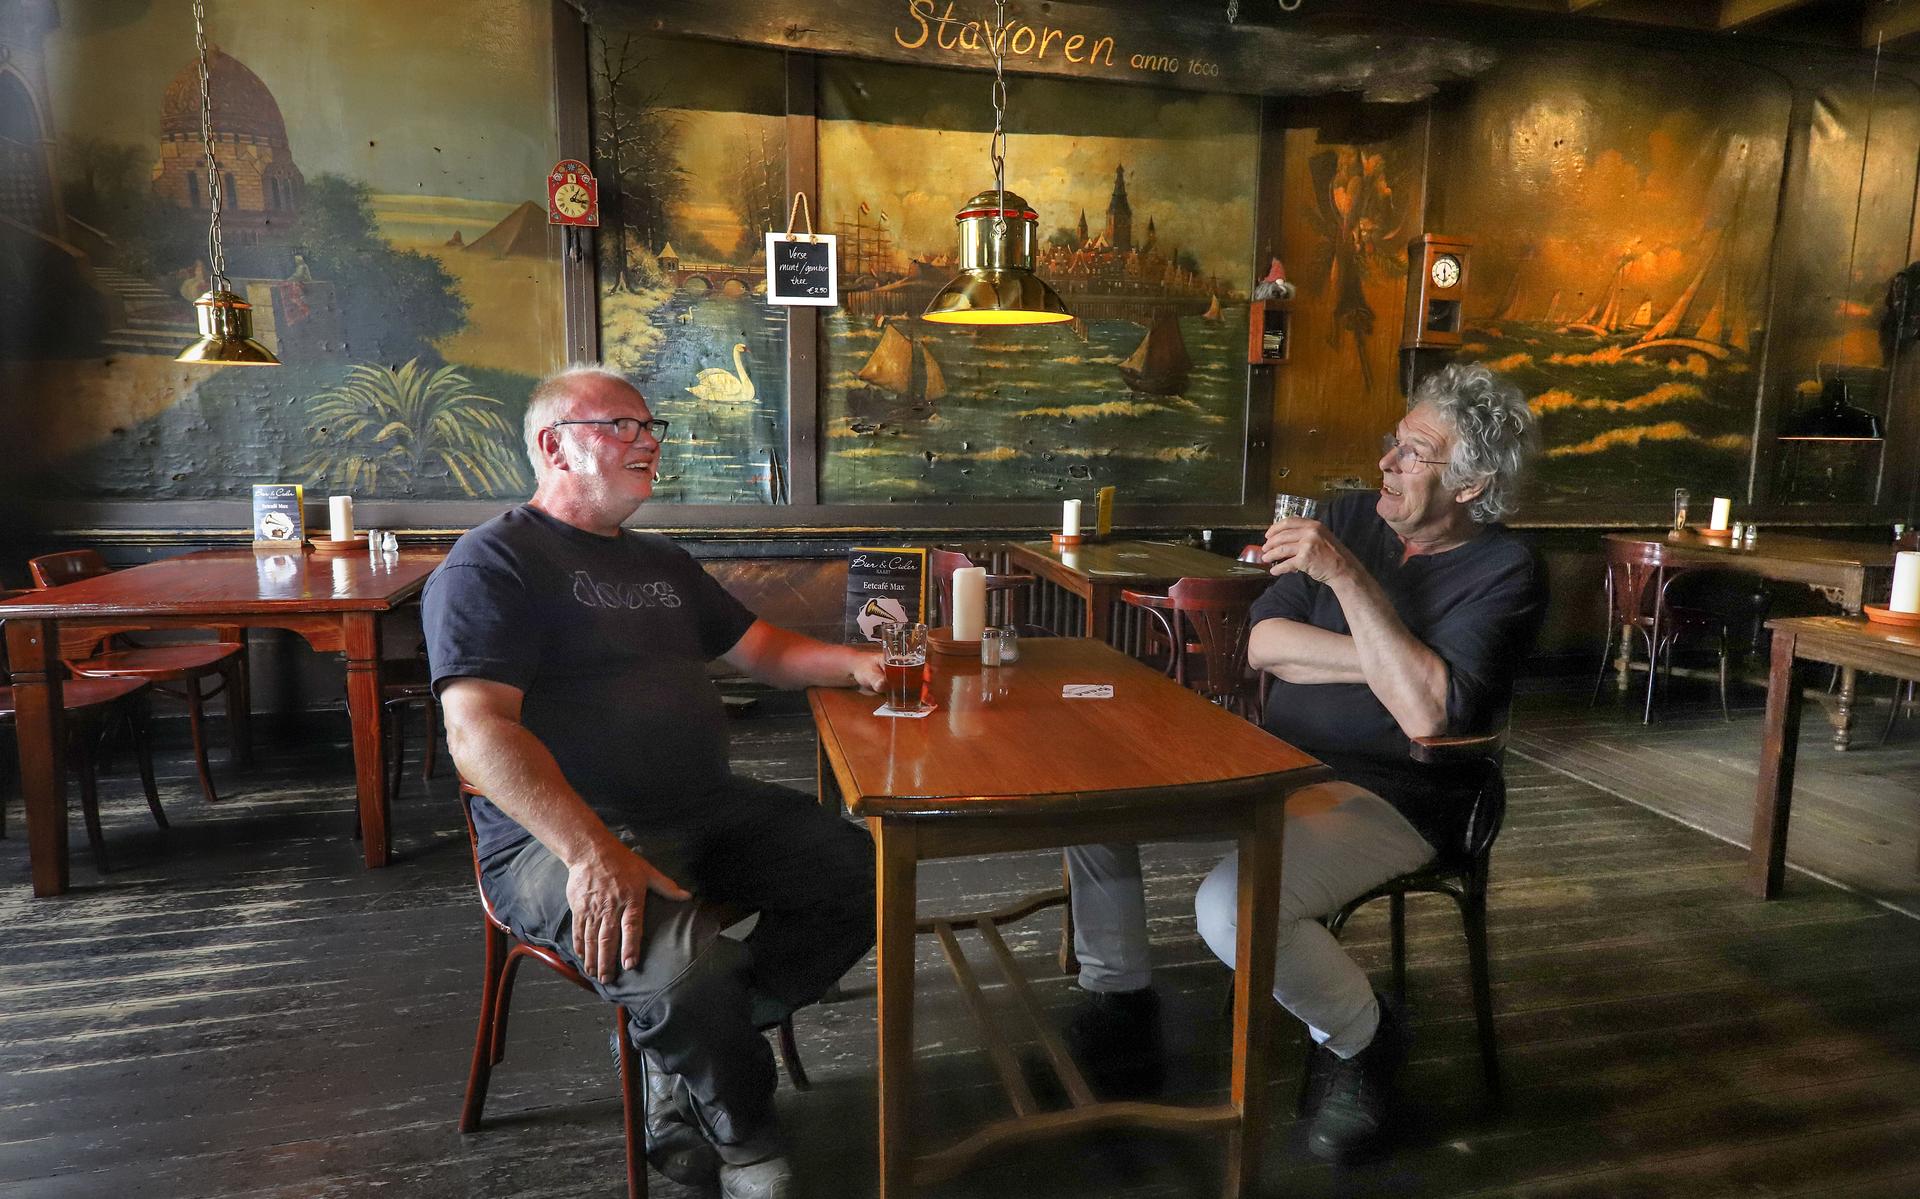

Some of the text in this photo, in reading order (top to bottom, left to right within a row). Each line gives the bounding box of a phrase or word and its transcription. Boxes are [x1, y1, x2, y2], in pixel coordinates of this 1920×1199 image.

[895, 0, 1220, 78] Stavoren anno 1600
[789, 246, 808, 260] Verse
[790, 275, 808, 285] thee
[851, 554, 918, 570] Bier & Cider
[863, 581, 905, 591] Eetcafé Max
